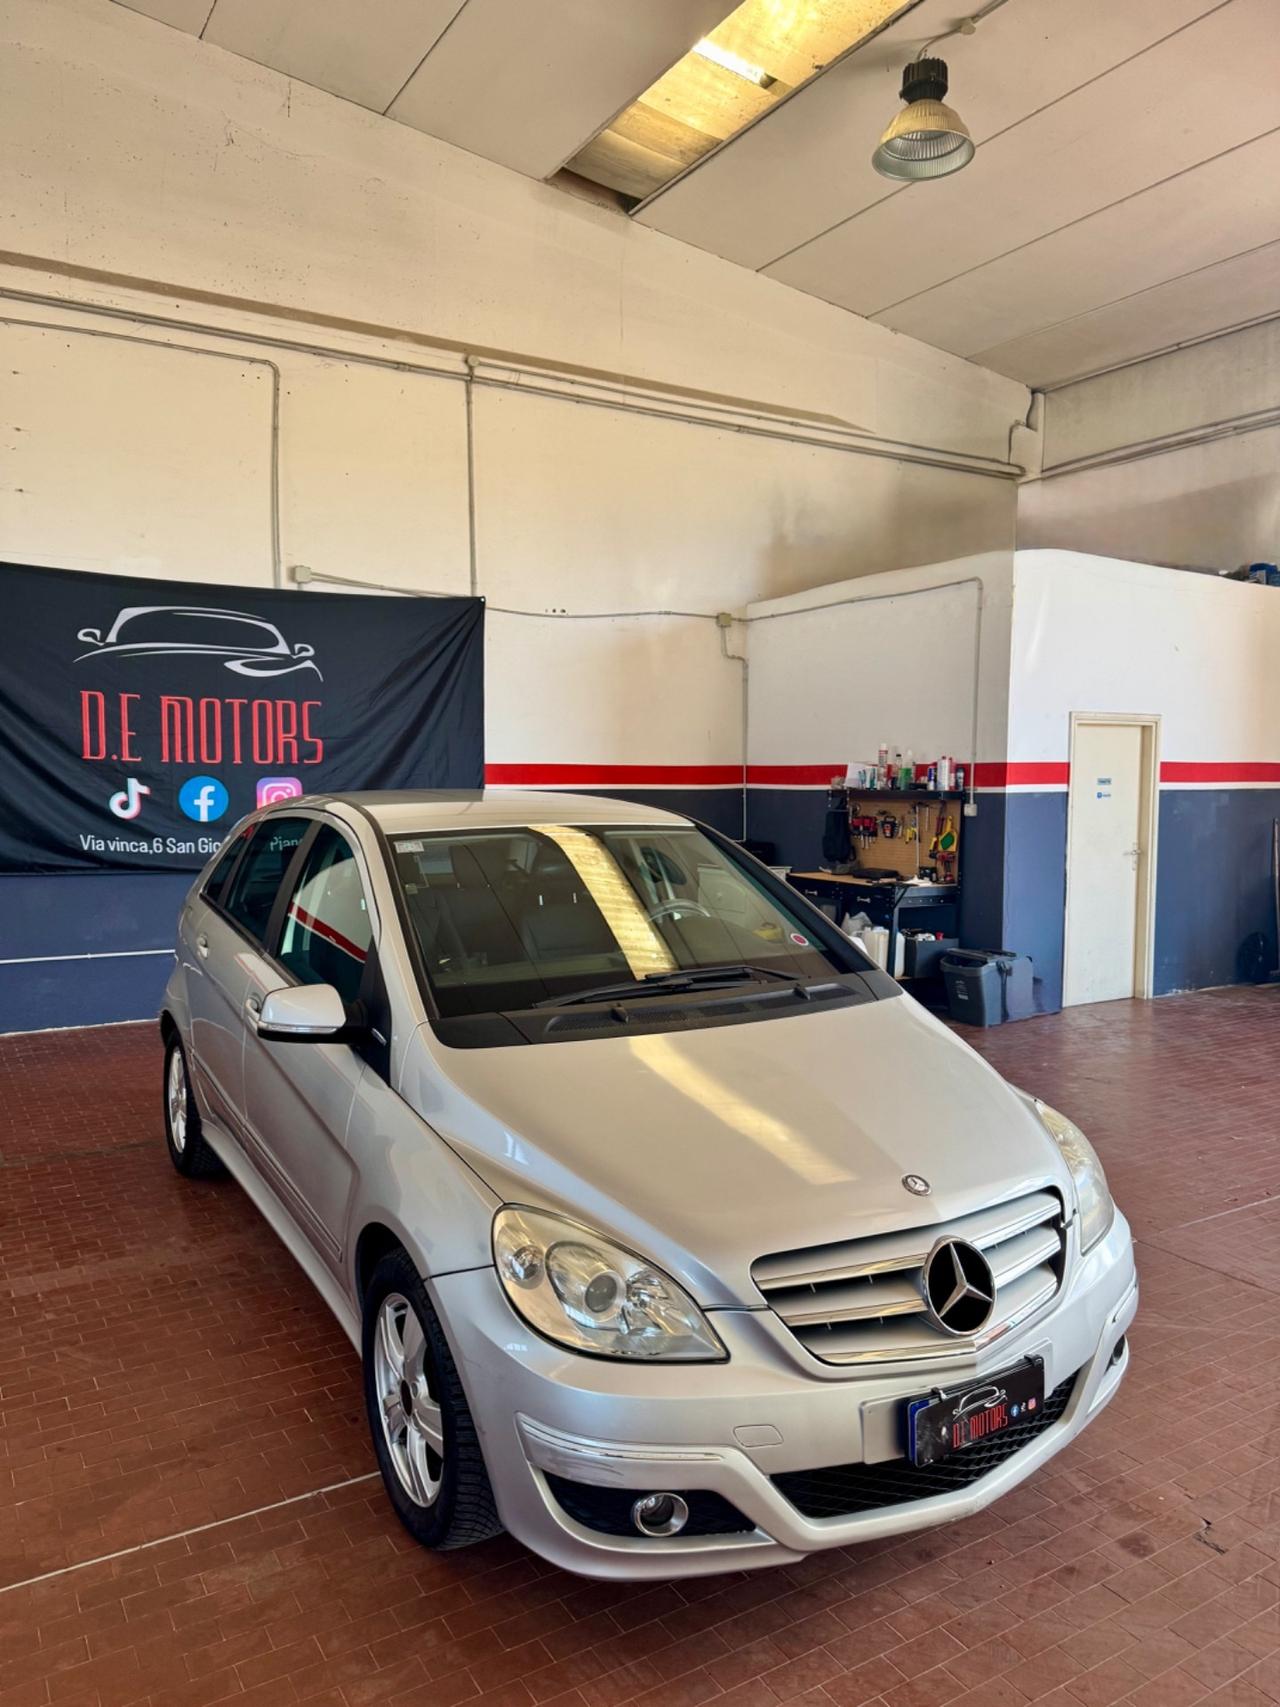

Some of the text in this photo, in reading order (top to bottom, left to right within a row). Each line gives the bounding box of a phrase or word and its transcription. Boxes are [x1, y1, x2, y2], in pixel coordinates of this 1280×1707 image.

[80, 690, 323, 765] D.E MOTORS
[80, 834, 104, 851] Via
[166, 838, 195, 854] San
